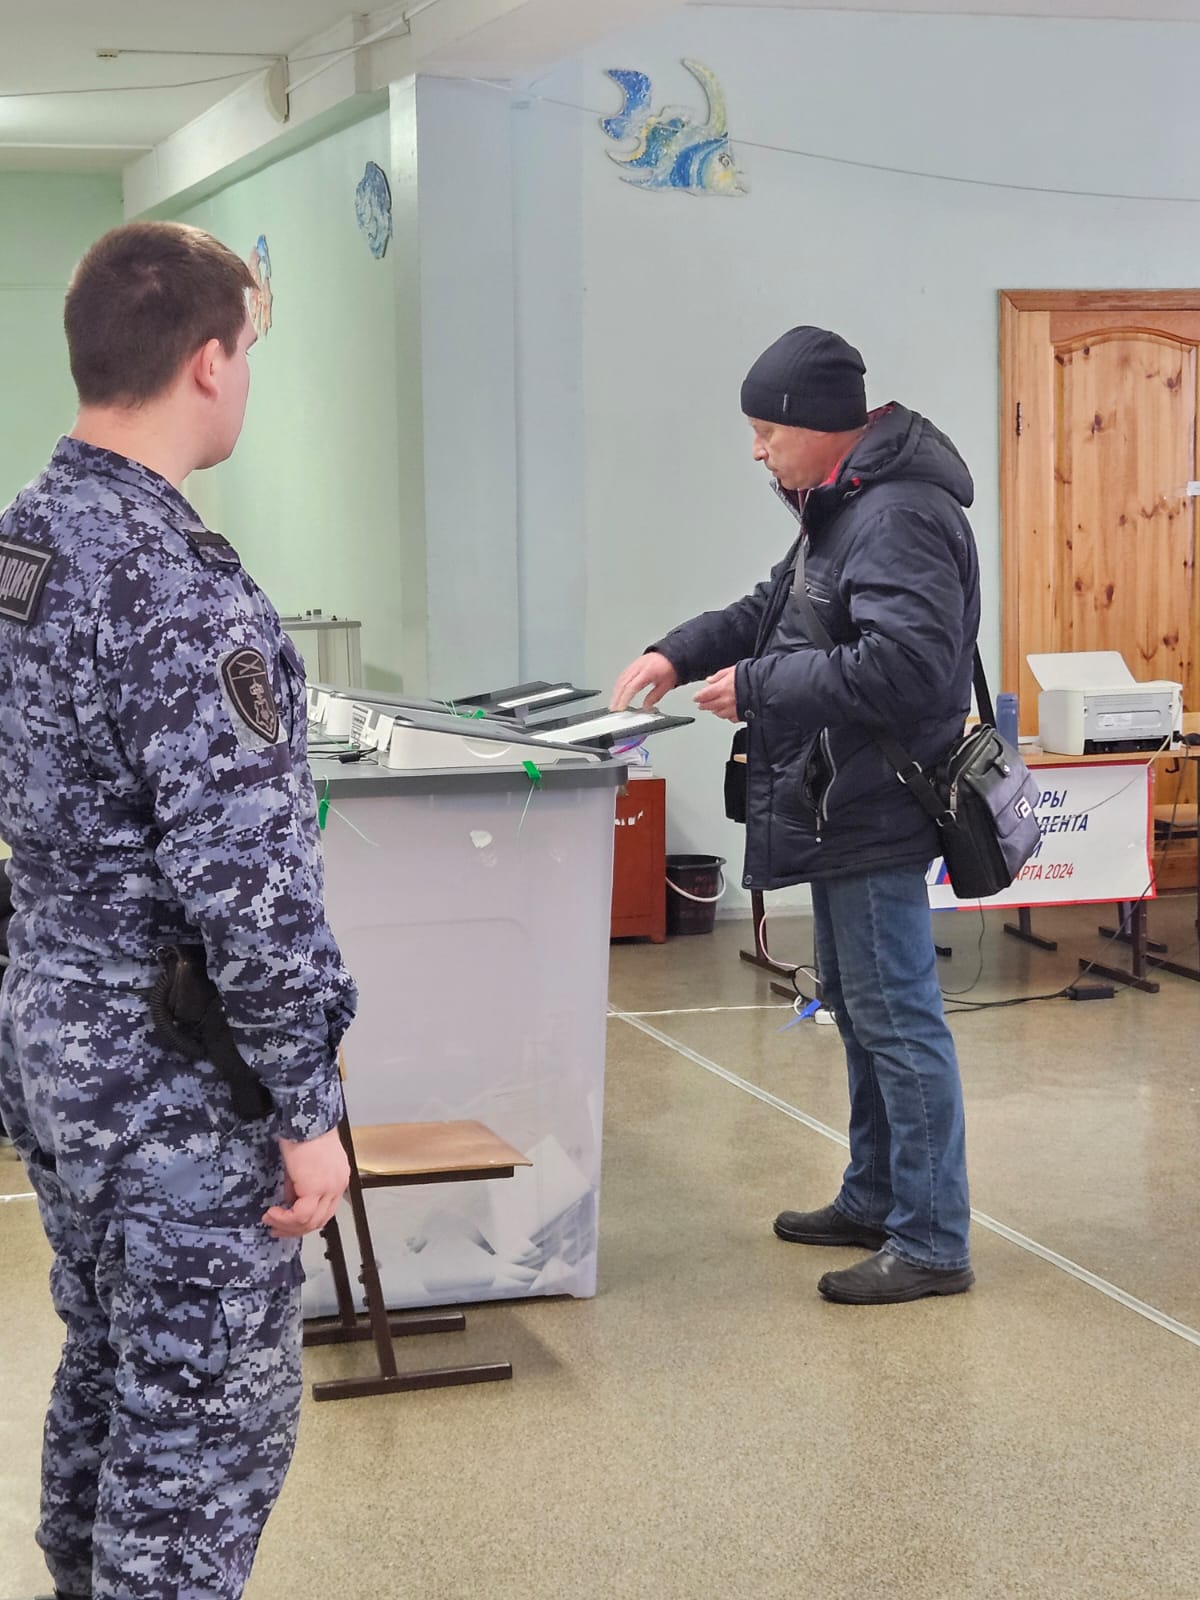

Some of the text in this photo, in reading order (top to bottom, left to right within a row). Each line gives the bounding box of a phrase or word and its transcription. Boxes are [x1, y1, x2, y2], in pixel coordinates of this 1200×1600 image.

[1038, 789, 1067, 808] РЫ
[1036, 814, 1088, 836] ДЕНТА
[1044, 862, 1074, 879] 2024
